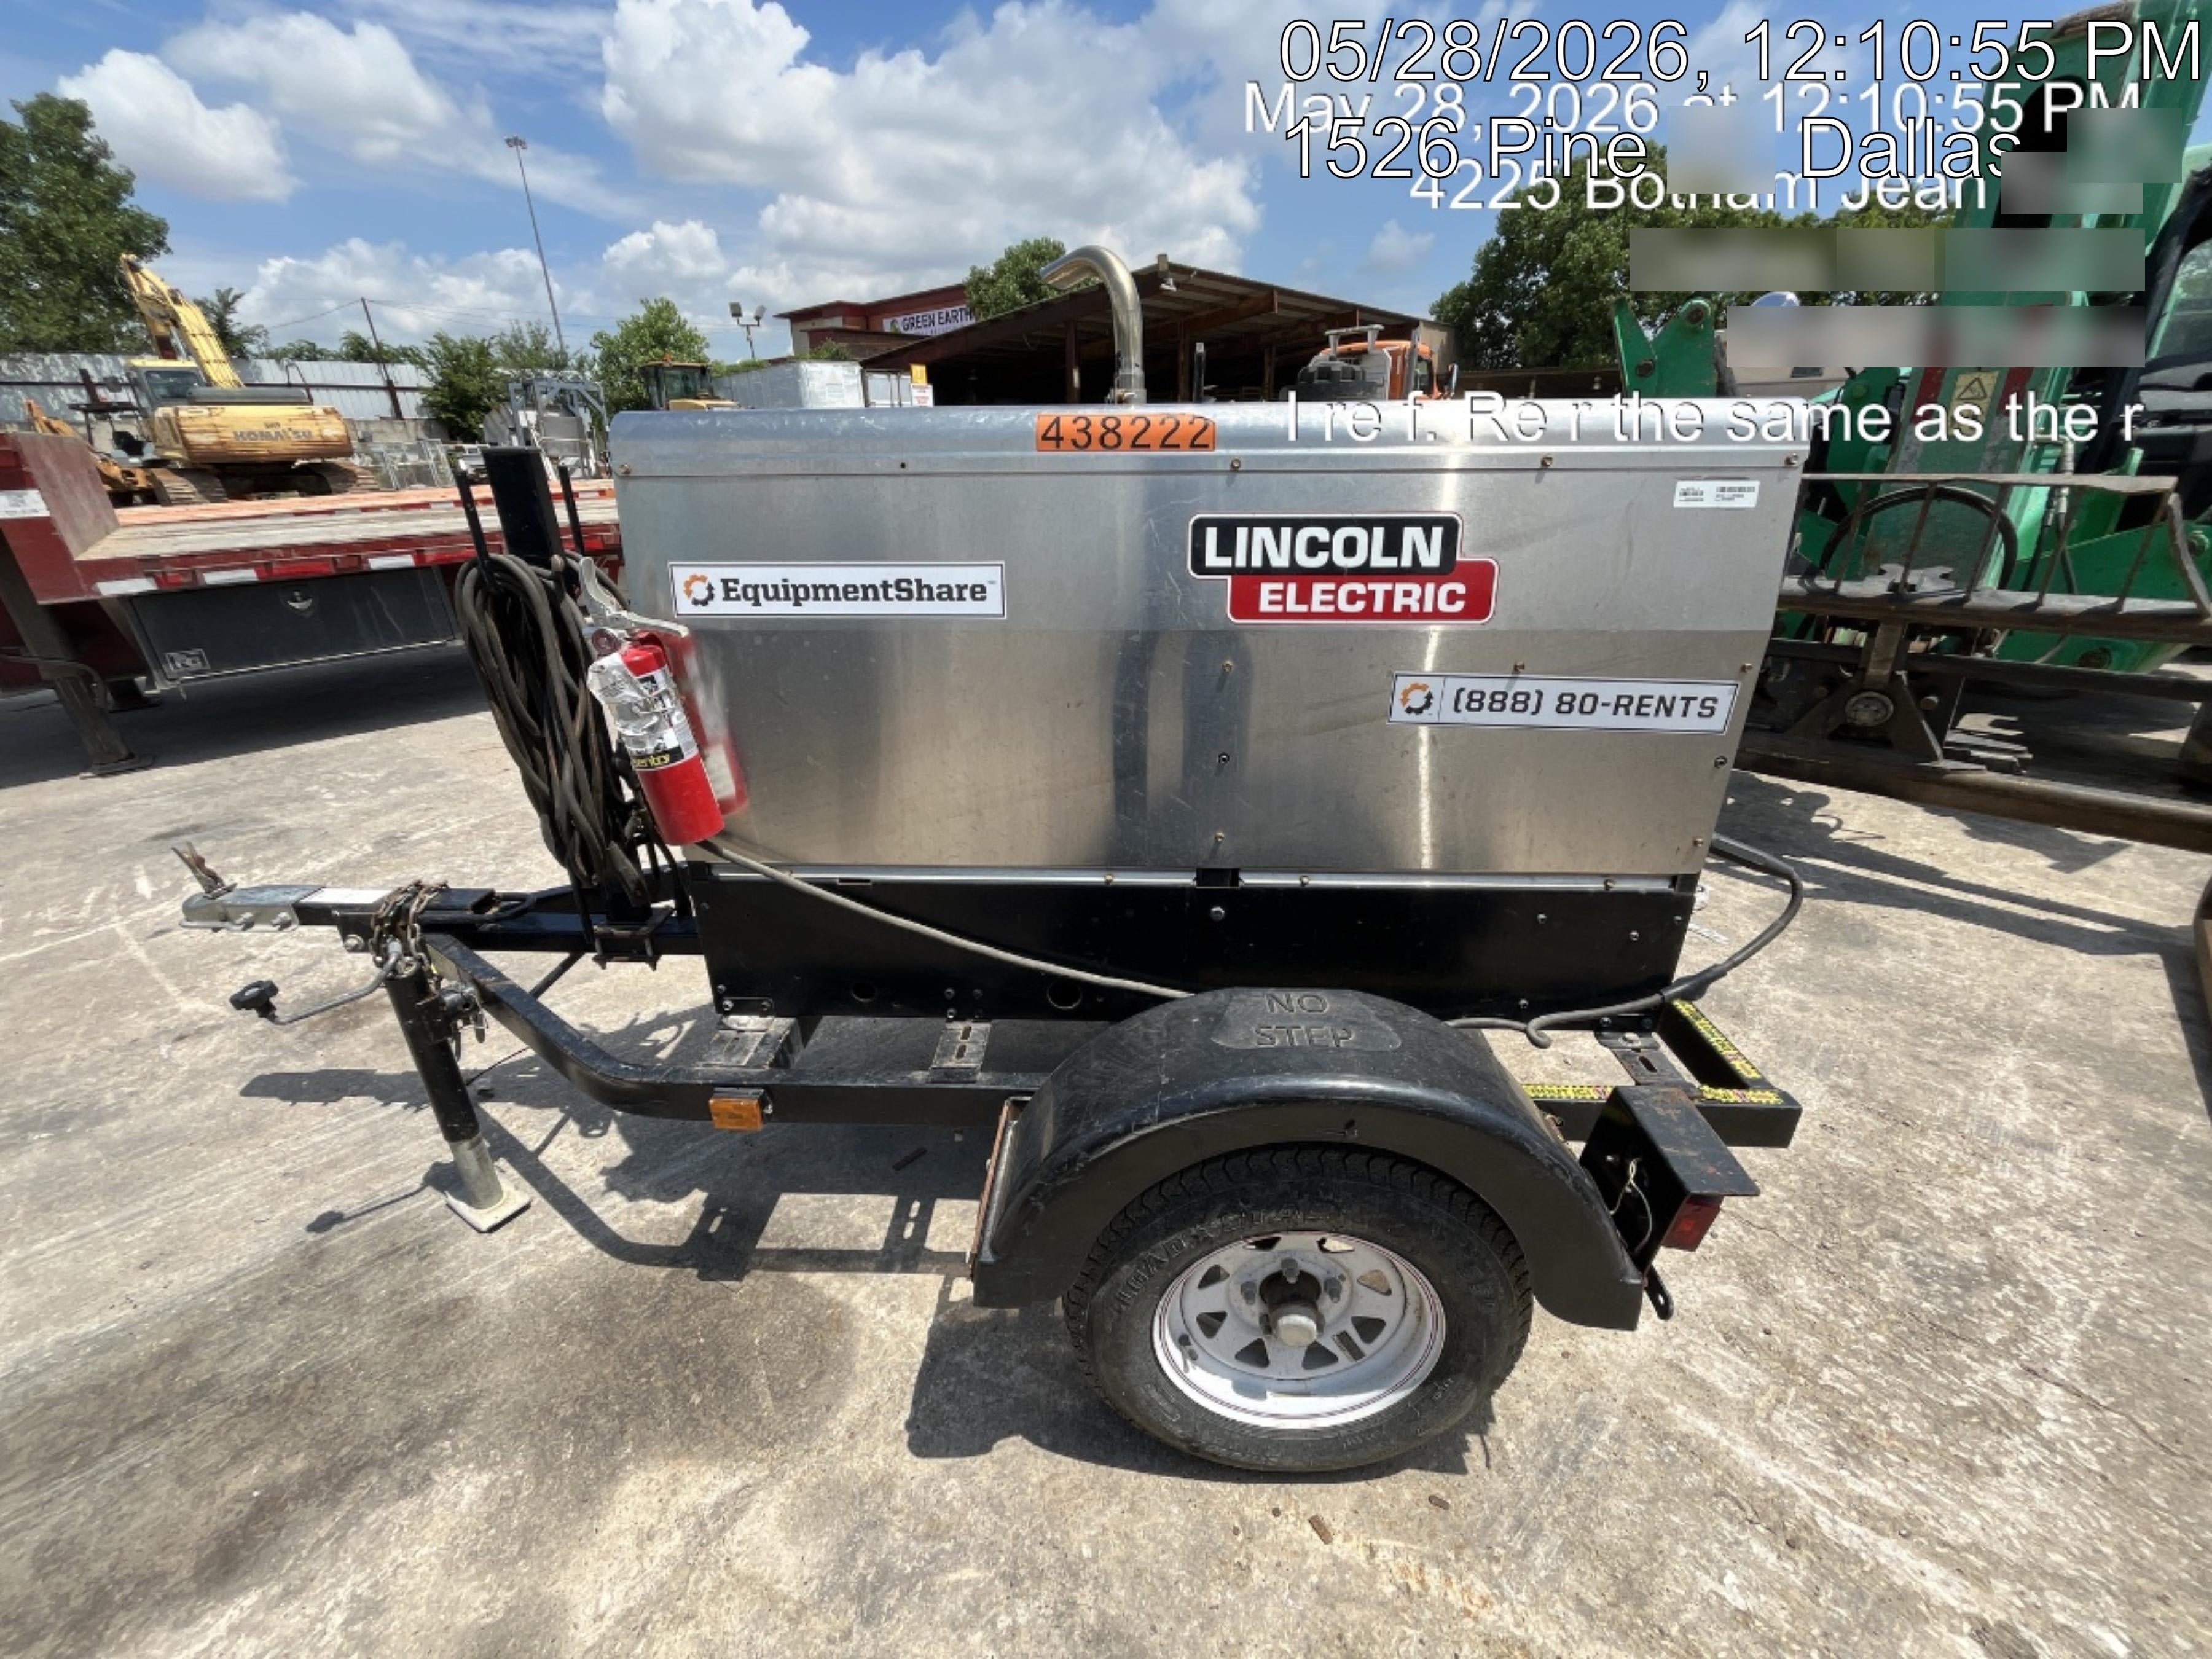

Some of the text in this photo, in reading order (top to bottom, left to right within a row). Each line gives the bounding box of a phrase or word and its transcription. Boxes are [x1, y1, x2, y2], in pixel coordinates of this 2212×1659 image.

[902, 307, 973, 331] GREEN EARTH
[1041, 415, 1210, 449] 438222
[1204, 526, 1444, 568] LINCOLN
[720, 578, 987, 607] EquipmentShare
[1258, 582, 1467, 613] ELECTRIC
[1453, 686, 1719, 719] (888) 80-RENTS
[1266, 992, 1329, 1014] NO
[1255, 1024, 1355, 1048] STEP
